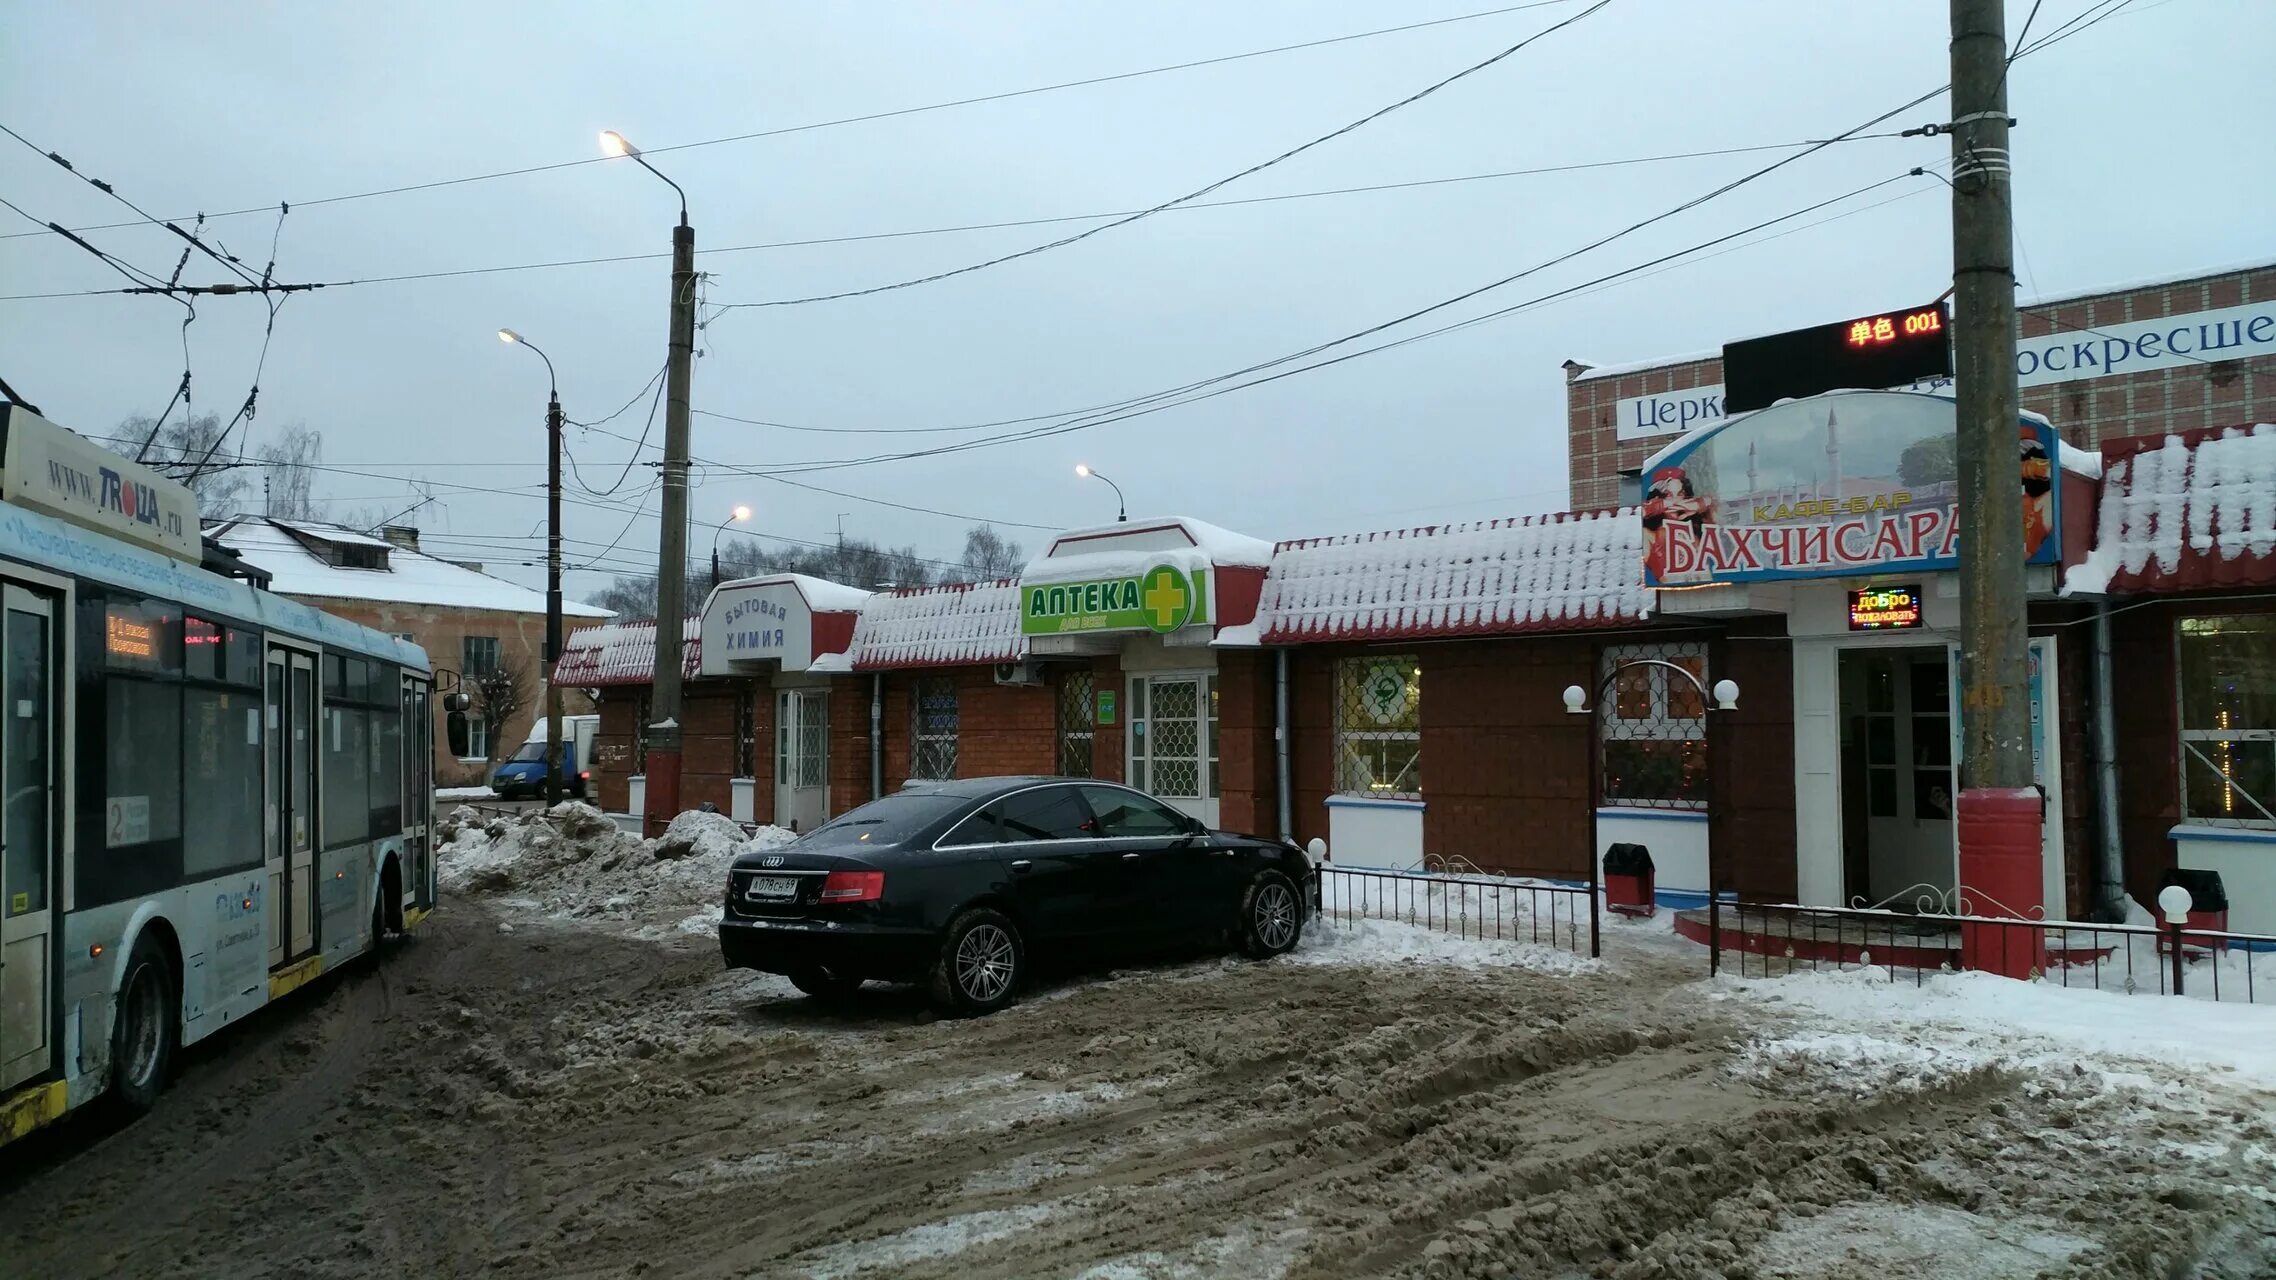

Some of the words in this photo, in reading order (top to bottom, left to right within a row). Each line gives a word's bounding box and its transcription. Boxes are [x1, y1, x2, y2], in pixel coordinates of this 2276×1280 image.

[1849, 317, 1895, 345] 单色
[1905, 311, 1941, 333] 001
[2016, 315, 2275, 375] оскресше
[1753, 492, 1912, 522] КАФЕ-БАР
[1666, 502, 1960, 574] БАХЧИСАРА
[725, 598, 786, 625] БЫТОВАЯ
[1030, 579, 1141, 617] АПТЕКА
[1854, 610, 1917, 623] пожаловать
[726, 629, 784, 650] ХИМИЯ
